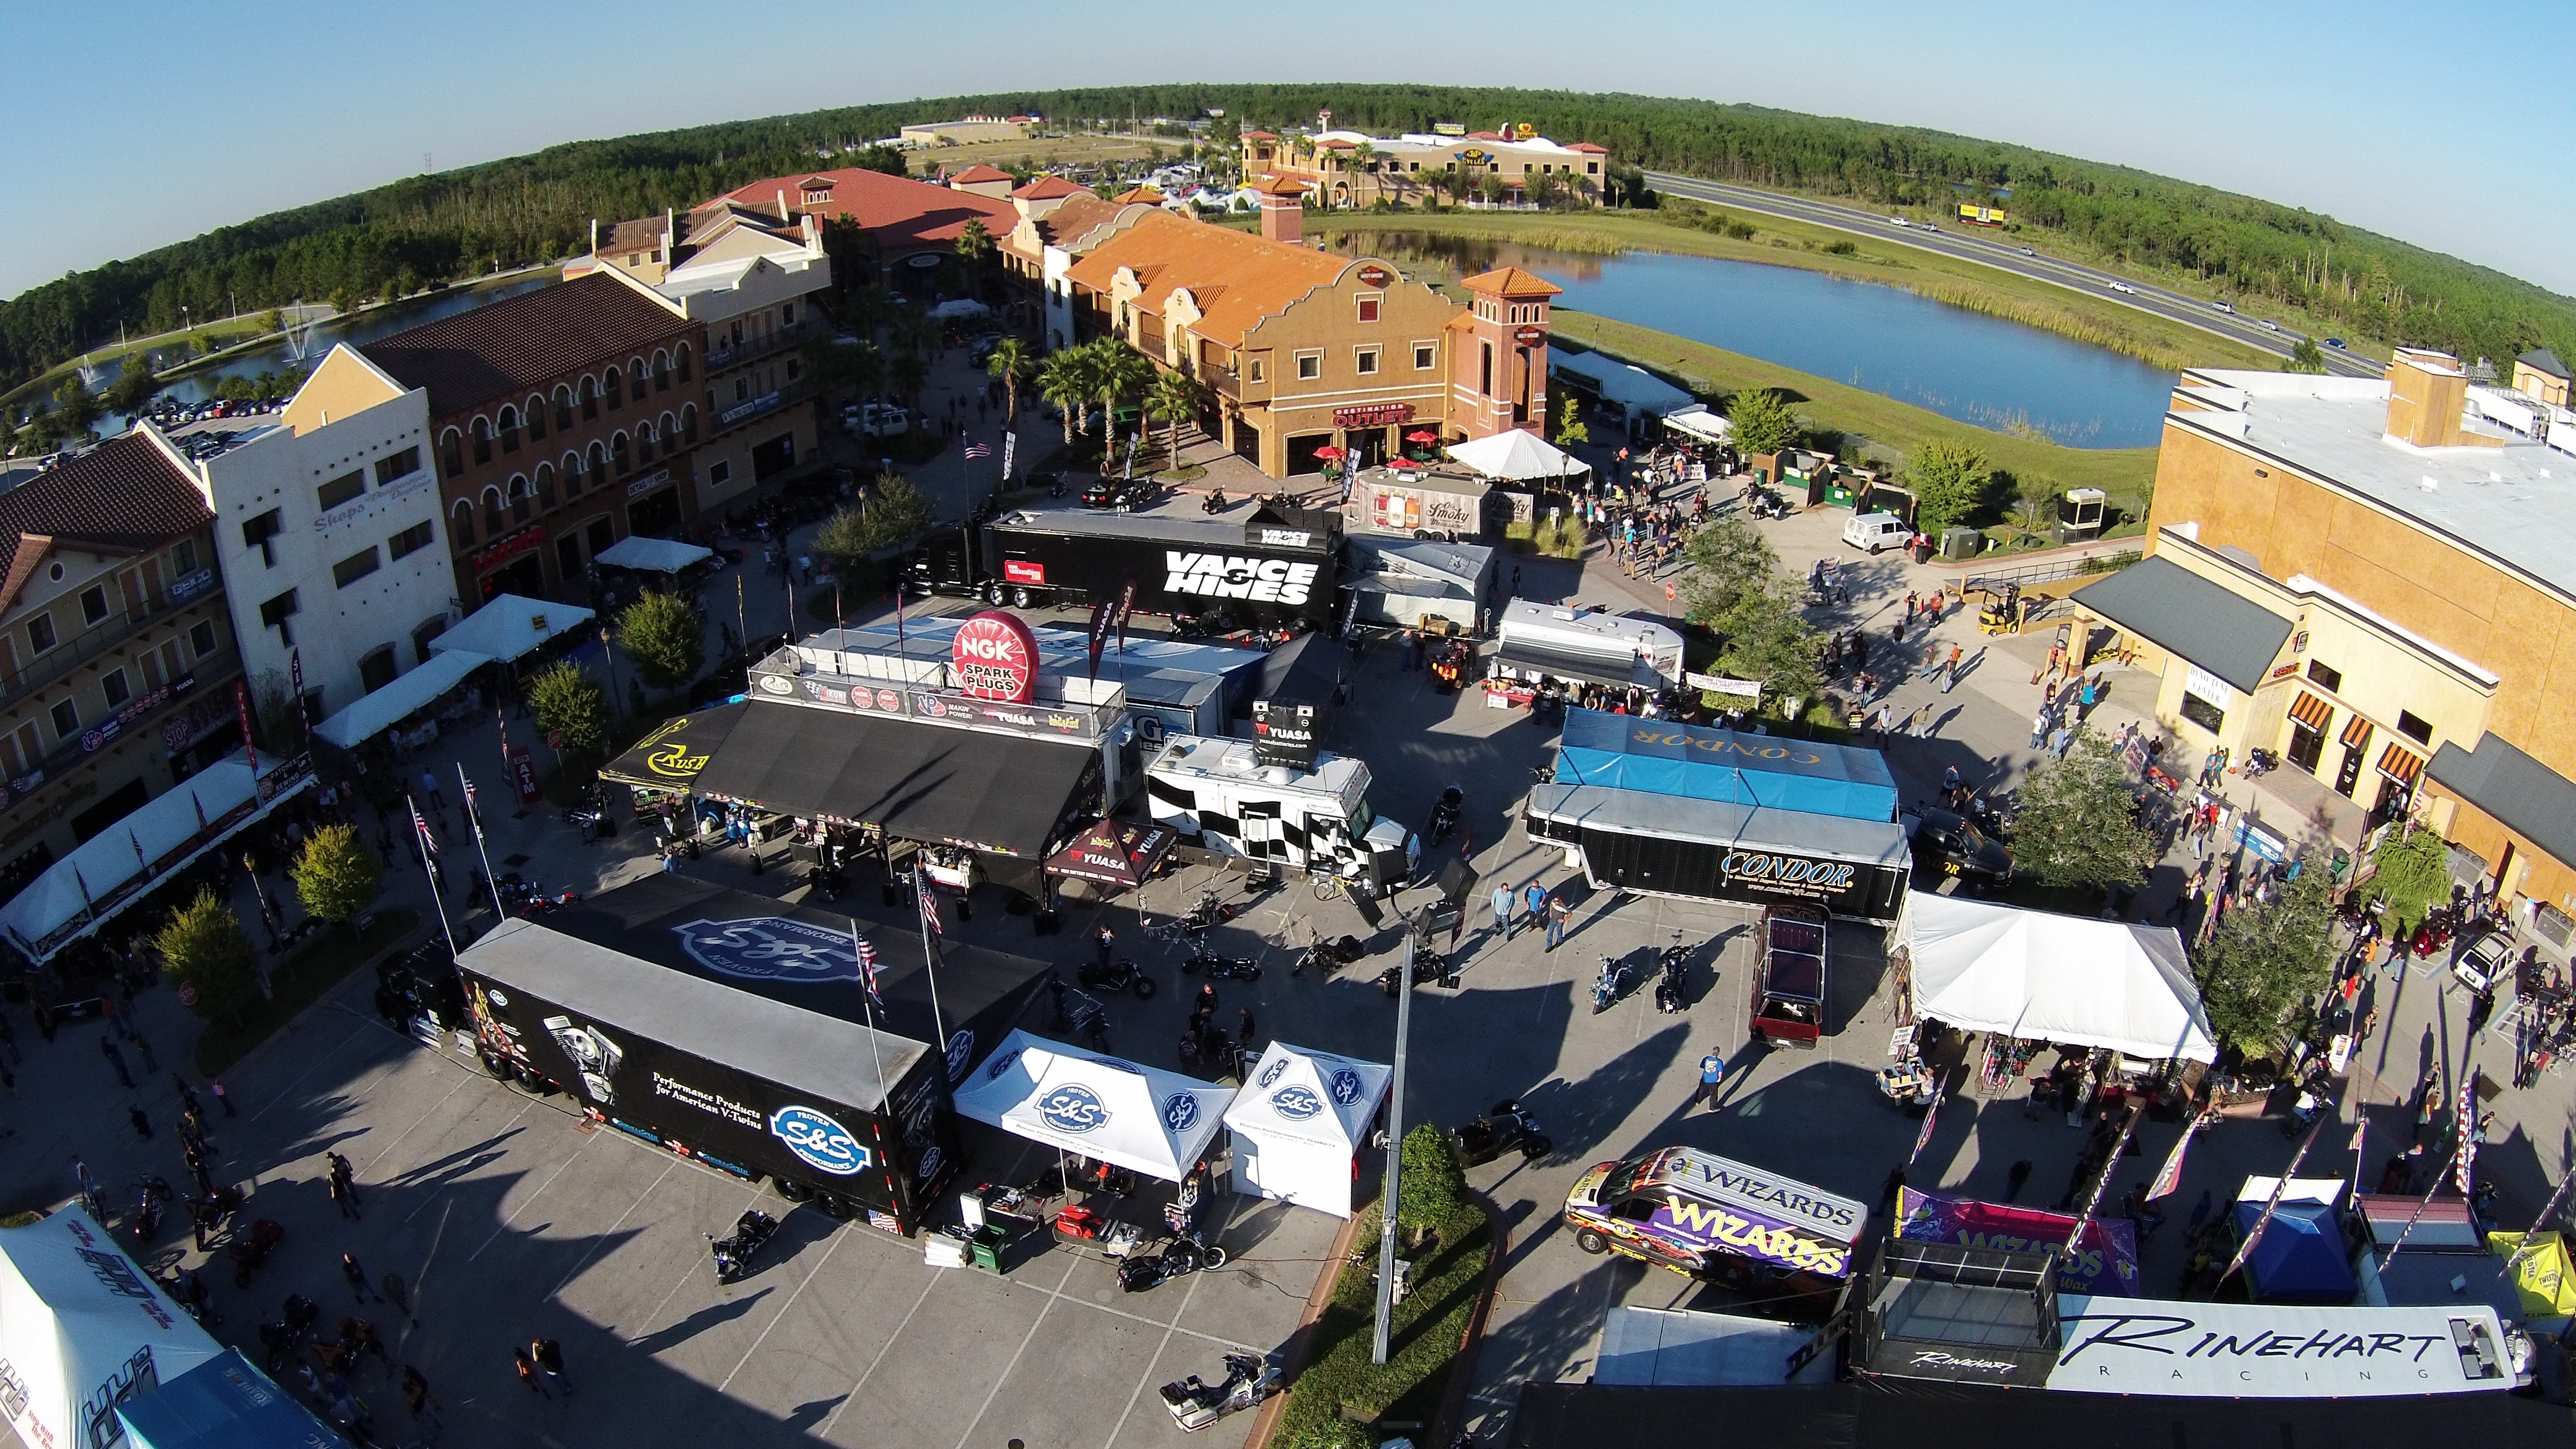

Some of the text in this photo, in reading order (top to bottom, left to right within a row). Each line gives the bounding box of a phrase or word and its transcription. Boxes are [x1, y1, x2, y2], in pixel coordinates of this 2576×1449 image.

[1333, 410, 1407, 427] OUTLET
[1336, 404, 1404, 415] DESTINATION
[1426, 502, 1470, 525] Smoky
[1261, 536, 1309, 548] HINES
[1262, 529, 1311, 540] VANCE
[1166, 551, 1319, 585] VANCE
[1163, 572, 1310, 605] HINES
[1096, 602, 1113, 642] YUASA
[962, 638, 1012, 662] NGK
[965, 665, 1012, 679] SPARK
[966, 676, 1014, 691] PLUGS
[948, 704, 971, 713] MAKIN'
[948, 710, 973, 720] POWER!
[998, 712, 1036, 726] YUASA
[237, 692, 256, 764] PATCHES
[1269, 727, 1312, 741] YUASA
[1259, 738, 1307, 750] yuasabatteries.com
[1634, 728, 1820, 764] CONDOR
[270, 758, 297, 779] PATCHES
[648, 743, 710, 776] RUSH
[275, 772, 300, 791] SEWING
[519, 763, 535, 794] ATM
[1137, 829, 1163, 854] YUASA
[1084, 853, 1126, 871] YUASA
[1721, 851, 1853, 887] CONDOR
[707, 953, 775, 975] PROVEN
[1264, 1062, 1285, 1085] S&S
[653, 1072, 761, 1119] Performance Products
[1066, 1087, 1090, 1098] PROVEN
[1336, 1072, 1356, 1103] S&S
[655, 1084, 762, 1131] for American V-Twins
[1045, 1096, 1101, 1123] S&S
[1169, 1096, 1193, 1127] S&S
[1276, 1094, 1317, 1112] S&S
[796, 1111, 830, 1127] PROVEN
[1046, 1116, 1086, 1131] PERFORMANCE
[786, 1120, 852, 1159] S&S
[799, 1148, 851, 1170] PERFORMANCE
[1702, 1164, 1854, 1226] WIZARDS
[1667, 1195, 1845, 1274] WIZARDS
[2060, 1277, 2091, 1292] Wax
[2059, 1314, 2446, 1366] RINEHART
[1910, 1351, 2018, 1370] RINEHART
[2099, 1365, 2429, 1383] RACING
[28, 1410, 54, 1443] Stop With
[31, 1424, 43, 1440] The
